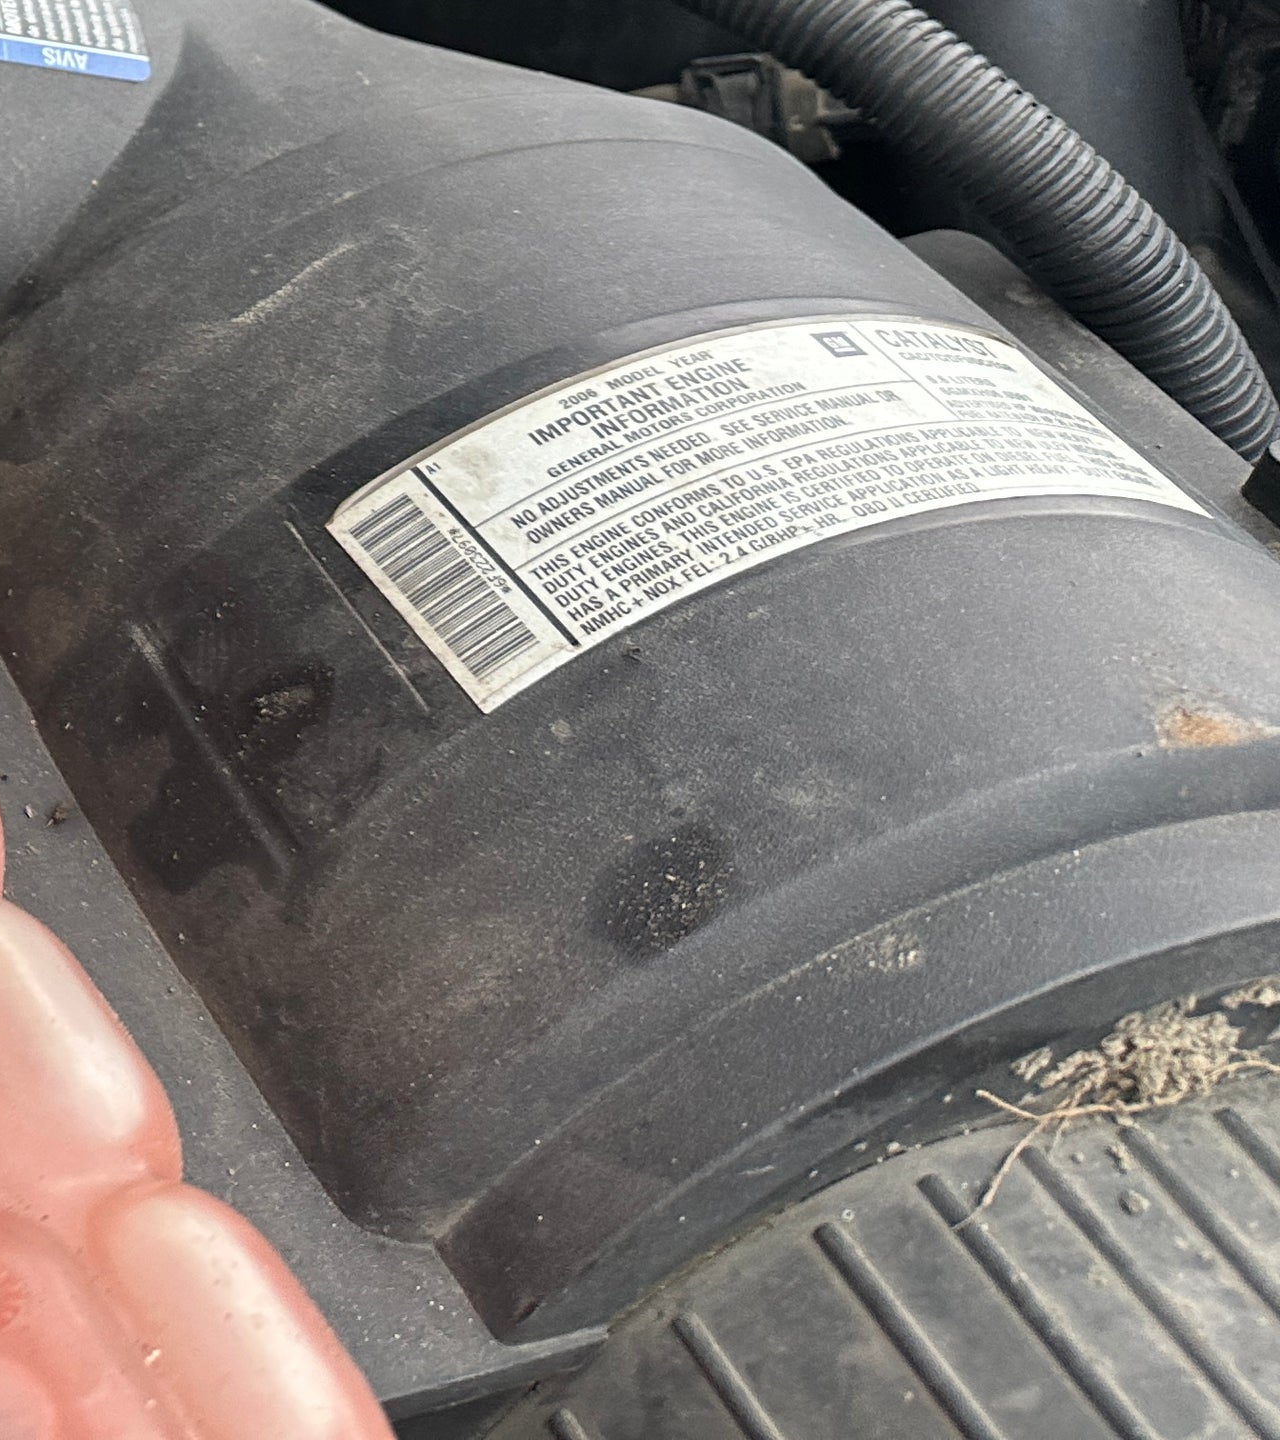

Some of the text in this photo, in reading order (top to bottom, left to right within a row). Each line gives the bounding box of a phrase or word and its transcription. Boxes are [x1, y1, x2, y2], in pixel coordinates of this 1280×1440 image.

[42, 49, 88, 71] AVIS
[527, 357, 752, 448] IMPORTANT ENGINE
[557, 349, 715, 410] 2006 MODEL YEAR
[589, 374, 751, 441] INFORMATION
[875, 329, 996, 359] CATALYST
[509, 389, 903, 529] NO ADJUSTMENTS NEEDED. SEE SERVICE MANUAL OR
[523, 412, 854, 545] OWNERS MANUAL FOR MORE INFORMATION.
[545, 381, 809, 479] GENERAL MOTORS CORPORATION
[527, 552, 571, 581] THIS
[567, 520, 633, 559] ENGINE
[629, 482, 724, 529] CONFORMS
[719, 473, 747, 490] TO
[744, 461, 785, 482] U.S.
[780, 451, 819, 470] EPA
[814, 430, 922, 461] REGULATIONS
[916, 425, 1004, 440] APPLICABLE
[998, 426, 1024, 436] TO
[540, 562, 590, 595] DUTY
[586, 526, 662, 569] ENGINES
[657, 510, 699, 534] AND
[695, 474, 794, 518] CALIFORNIA
[790, 448, 901, 484] REGULATIONS
[895, 439, 986, 458] APPLICABLE
[981, 438, 1007, 449] TO
[552, 575, 603, 608] DUTY
[599, 537, 680, 582] ENGINES.
[676, 519, 721, 545] THIS
[717, 496, 782, 528] ENGINE
[778, 489, 803, 505] IS
[798, 467, 883, 499] CERTIFIED
[878, 463, 907, 477] TO
[901, 453, 974, 472] OPERATE
[968, 452, 998, 463] ON
[992, 451, 1046, 462] DIESEL
[566, 594, 605, 622] HAS
[602, 586, 621, 601] A
[617, 548, 698, 593] PRIMARY
[695, 514, 779, 556] INTENDED
[776, 492, 847, 523] SERVICE
[843, 471, 948, 502] APPLICATION
[943, 468, 971, 480] AS
[965, 467, 985, 477] A
[979, 464, 1028, 476] LIGHT
[578, 600, 633, 635] NMHC
[628, 594, 646, 608] +
[641, 575, 682, 601] NOX
[848, 499, 889, 517] OBD
